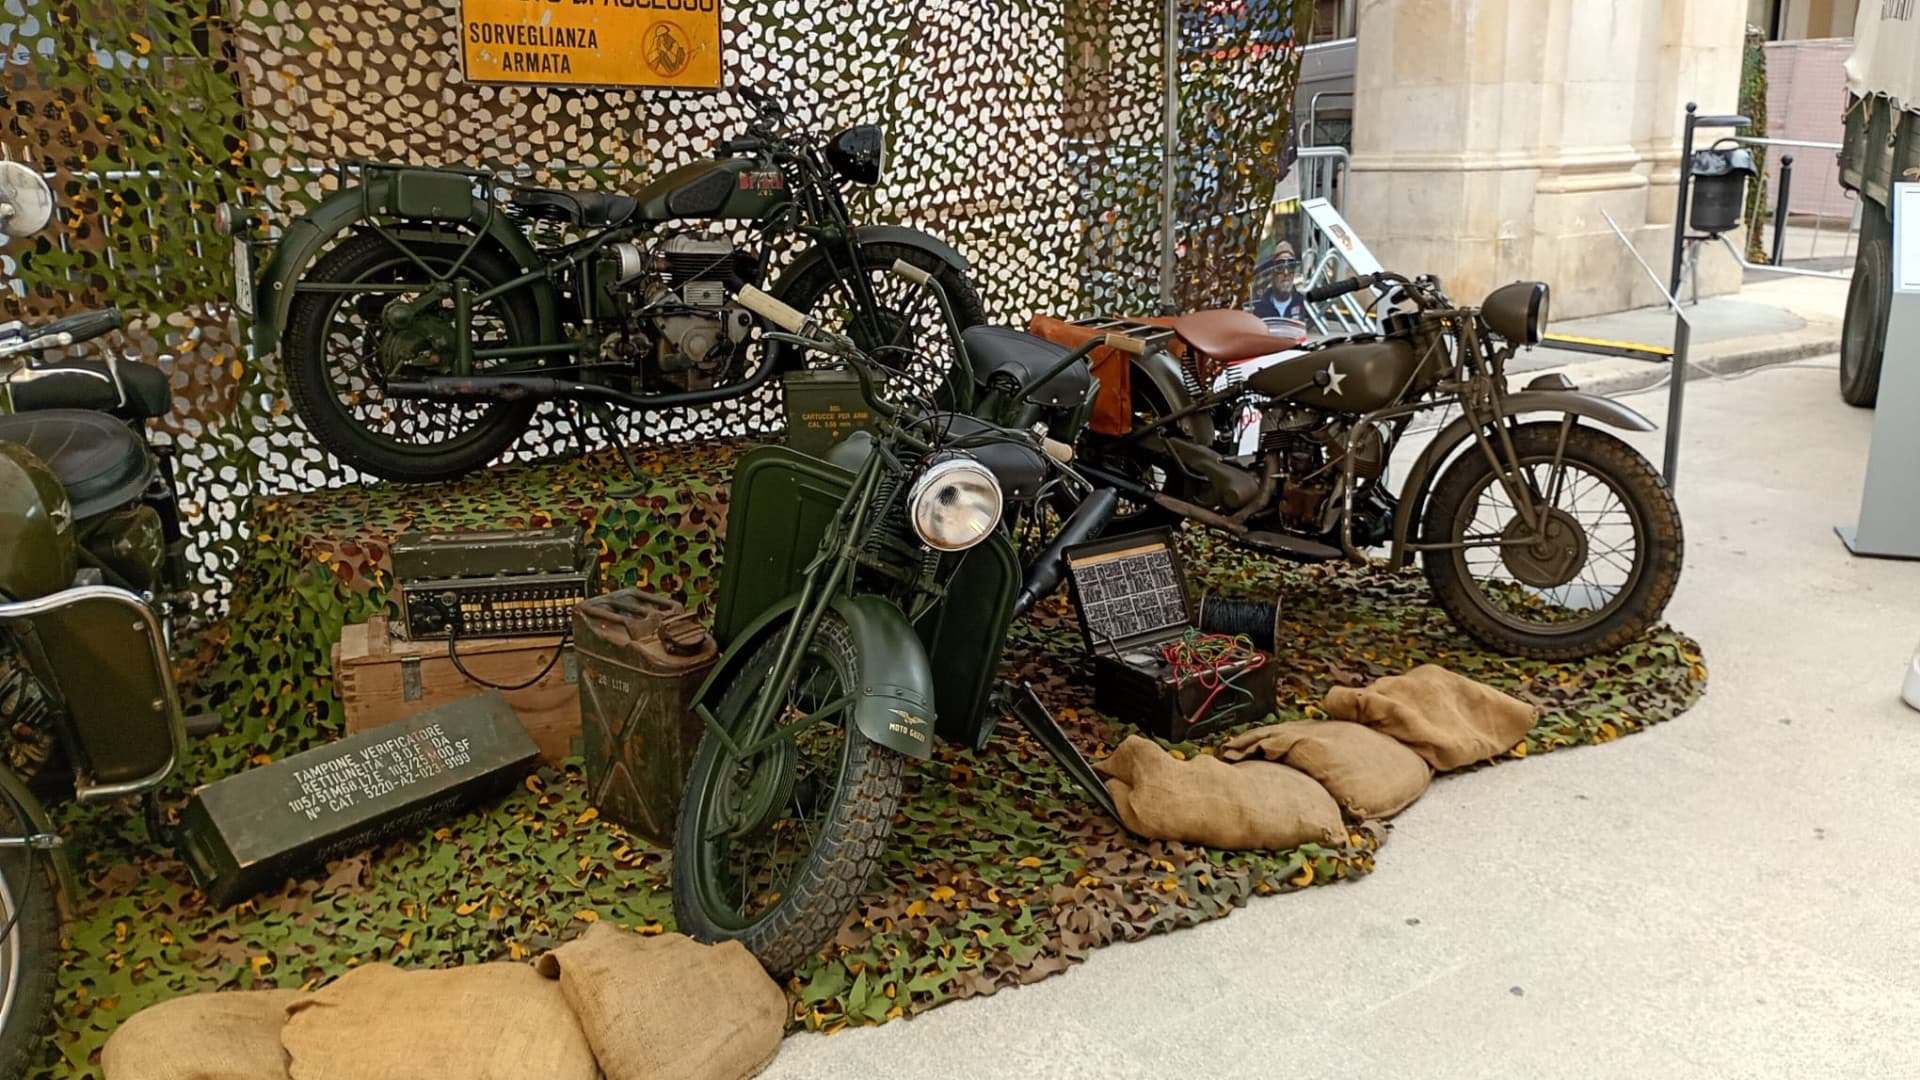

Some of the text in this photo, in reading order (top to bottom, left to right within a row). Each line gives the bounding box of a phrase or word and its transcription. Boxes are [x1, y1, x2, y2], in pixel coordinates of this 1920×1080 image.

[469, 22, 598, 49] SORVEGLIANZA
[502, 51, 572, 74] ARMATA
[889, 721, 908, 735] MOTO
[431, 735, 451, 749] DA
[292, 723, 445, 784] TAMPONE VERIFICATORE
[328, 794, 360, 813] CAT.
